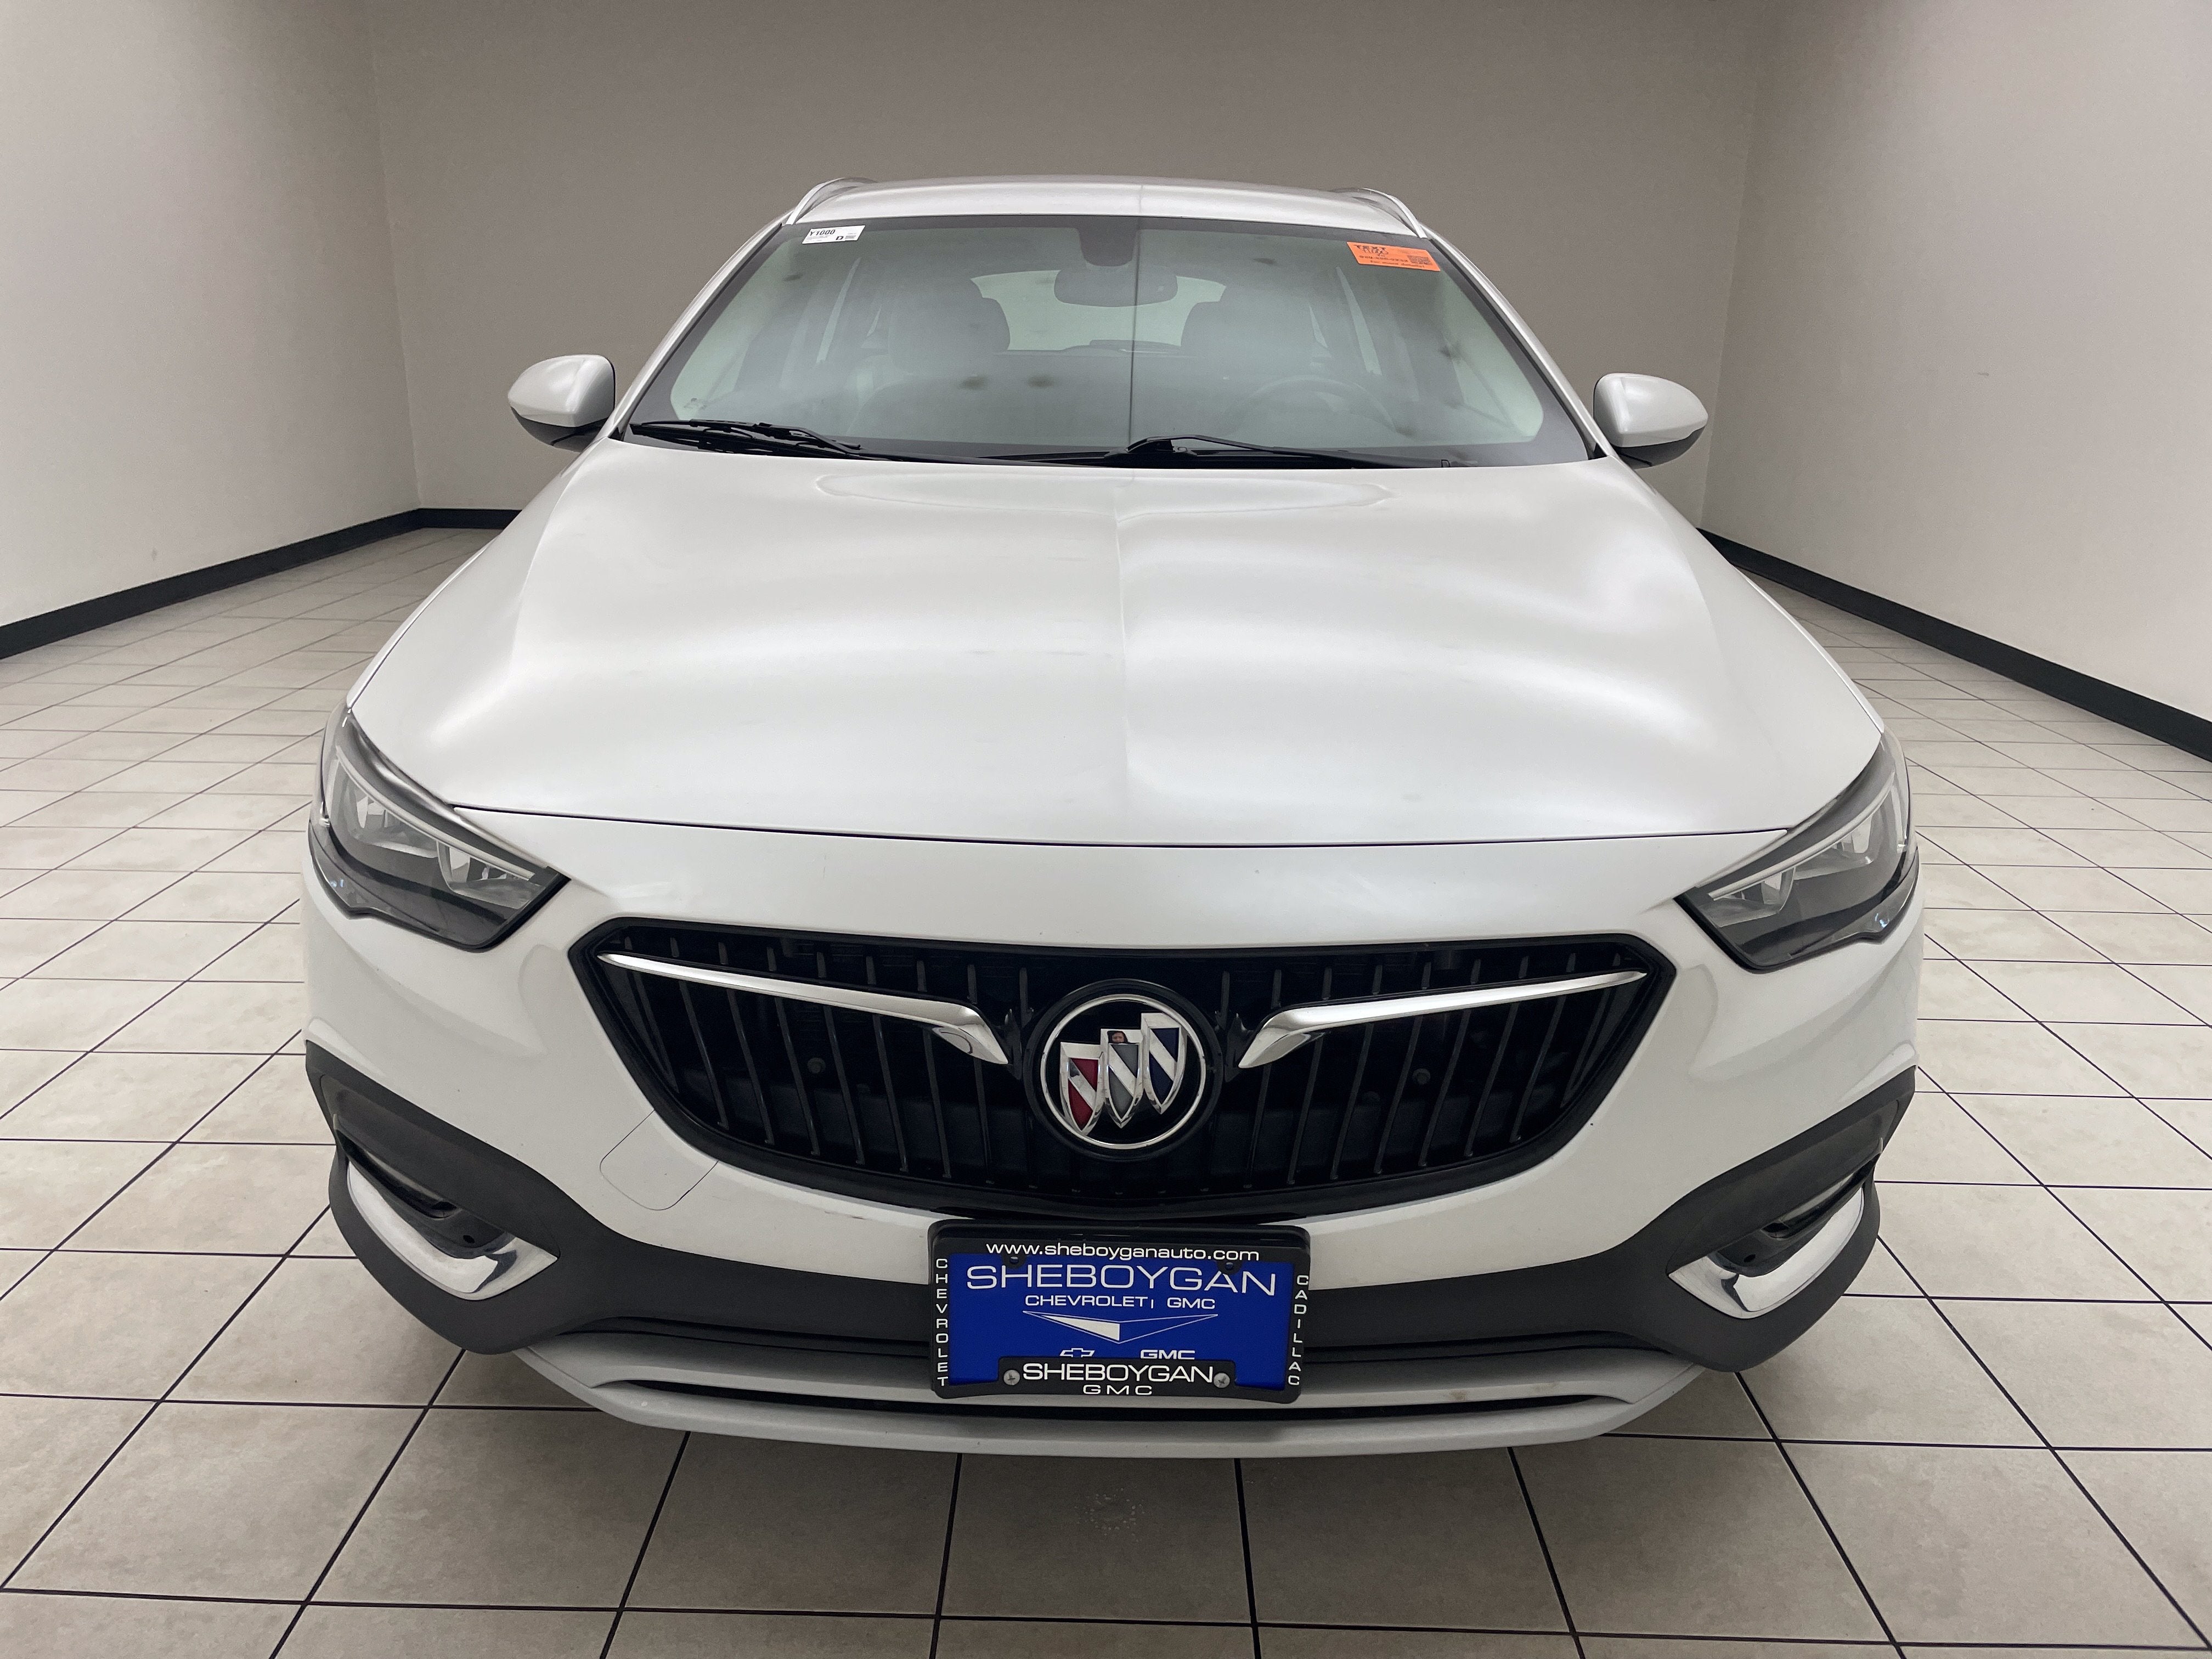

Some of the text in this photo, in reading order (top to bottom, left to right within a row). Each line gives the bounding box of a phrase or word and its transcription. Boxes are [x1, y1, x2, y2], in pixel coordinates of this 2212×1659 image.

[986, 1242, 1260, 1261] www.sheboyganauto.com
[967, 1264, 1276, 1296] SHEBOYGAN
[1025, 1295, 1216, 1310] CHEVROLET GMC
[935, 1259, 949, 1386] CHEVROLET
[1288, 1275, 1310, 1386] CADILLAC
[1140, 1349, 1196, 1360] GMC
[1023, 1363, 1214, 1384] SHEBOYGAN
[1083, 1384, 1153, 1396] GMC
